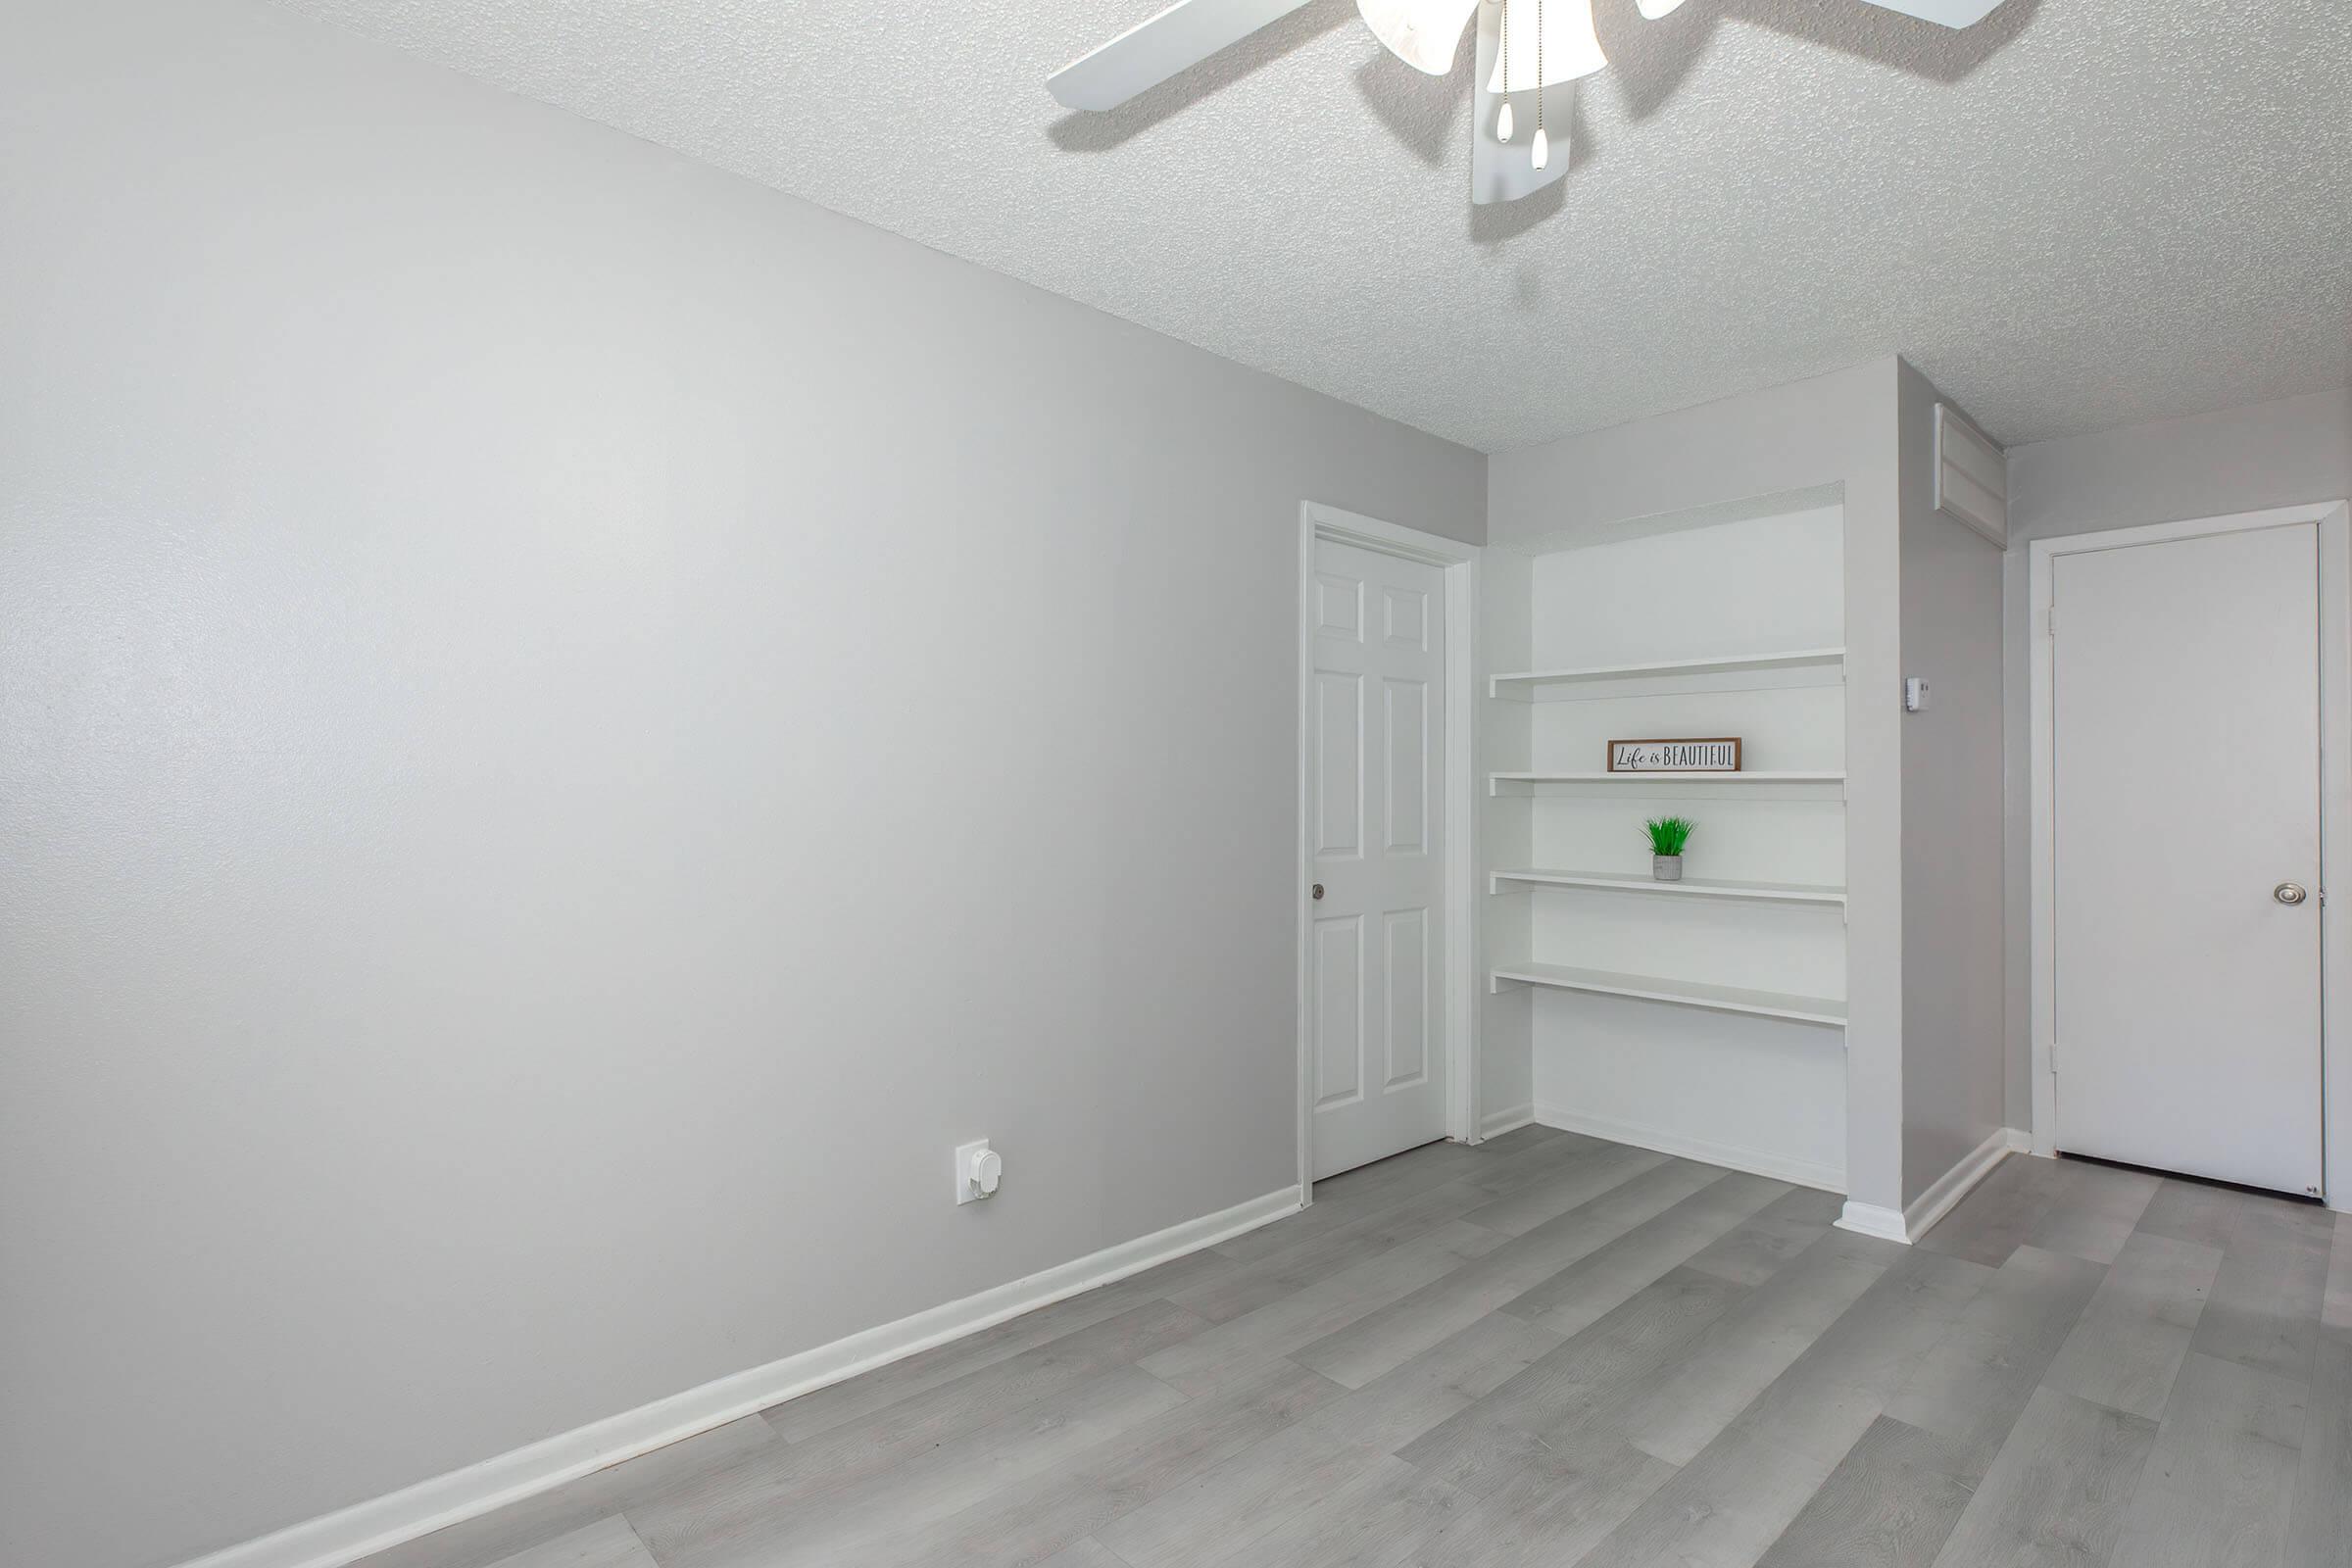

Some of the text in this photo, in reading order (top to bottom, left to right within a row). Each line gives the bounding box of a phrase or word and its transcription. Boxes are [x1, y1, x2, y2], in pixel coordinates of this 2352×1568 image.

[1617, 745, 1734, 769] Life is BEAUTIFUL
